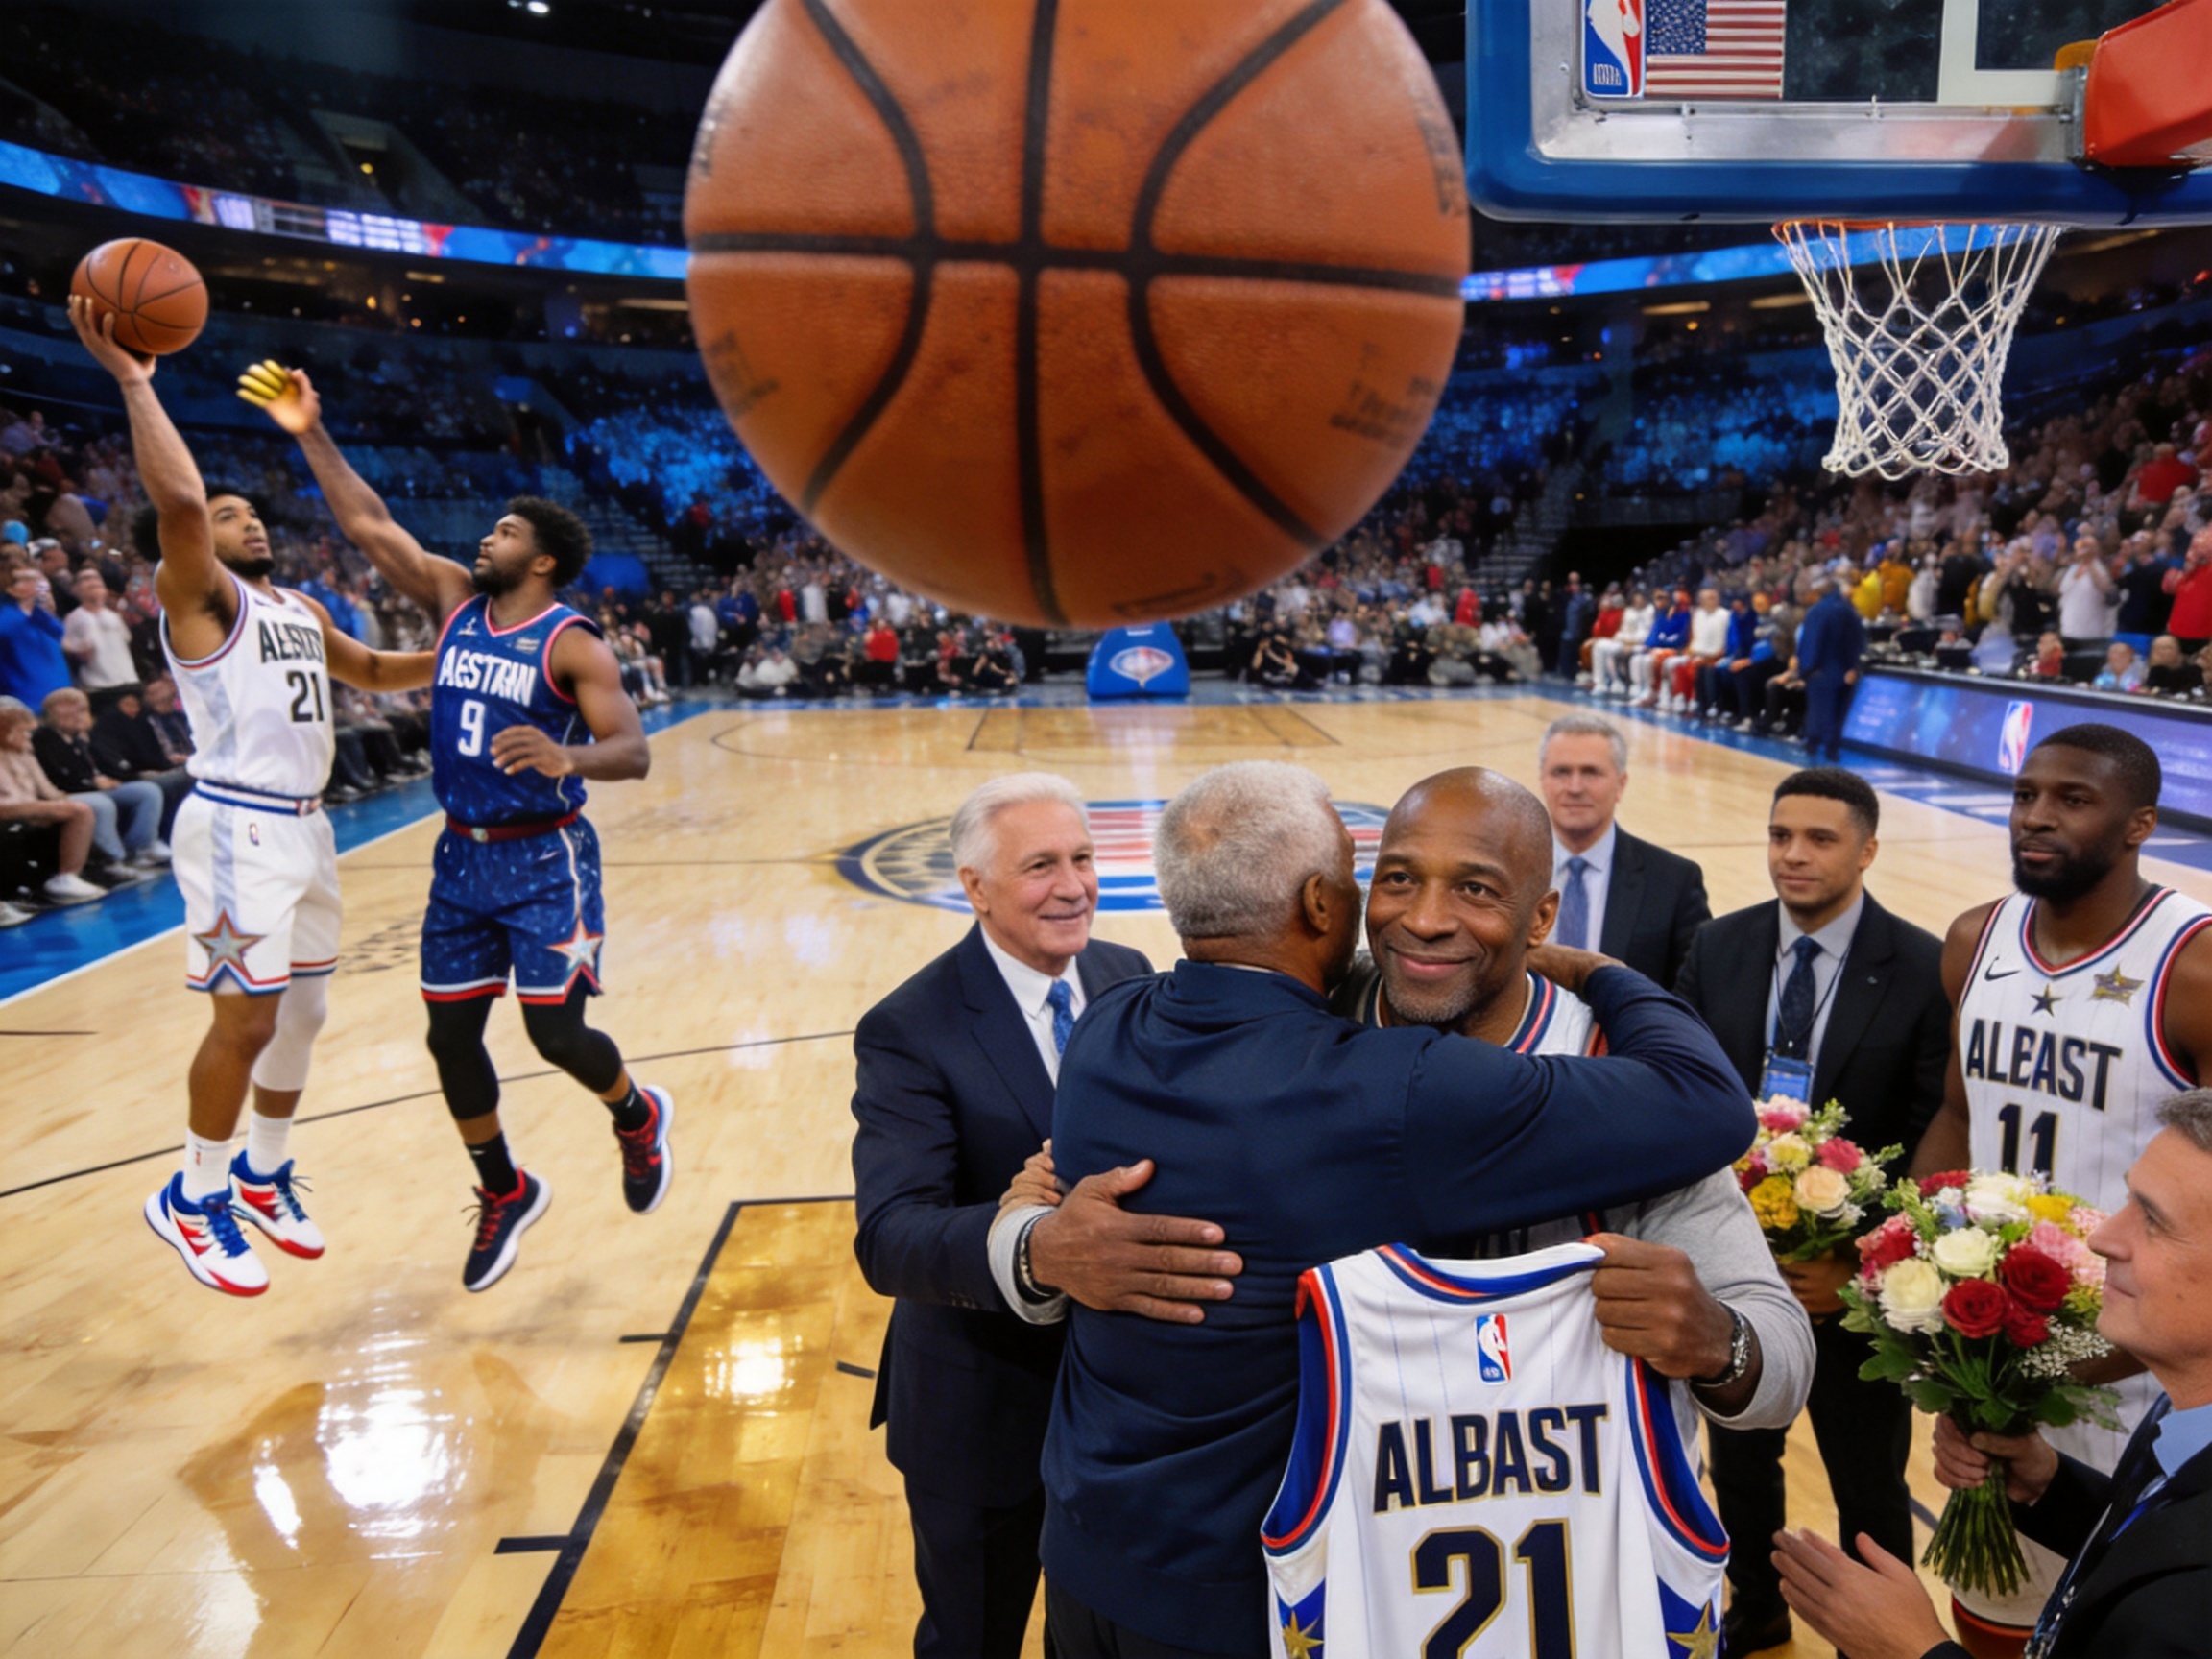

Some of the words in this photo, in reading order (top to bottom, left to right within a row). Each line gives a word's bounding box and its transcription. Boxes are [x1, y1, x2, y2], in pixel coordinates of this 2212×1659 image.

[285, 670, 325, 723] 21
[457, 698, 486, 757] 9
[1997, 1102, 2059, 1183] 11
[1373, 1403, 1610, 1515] ALBAST
[1410, 1516, 1578, 1659] 21
